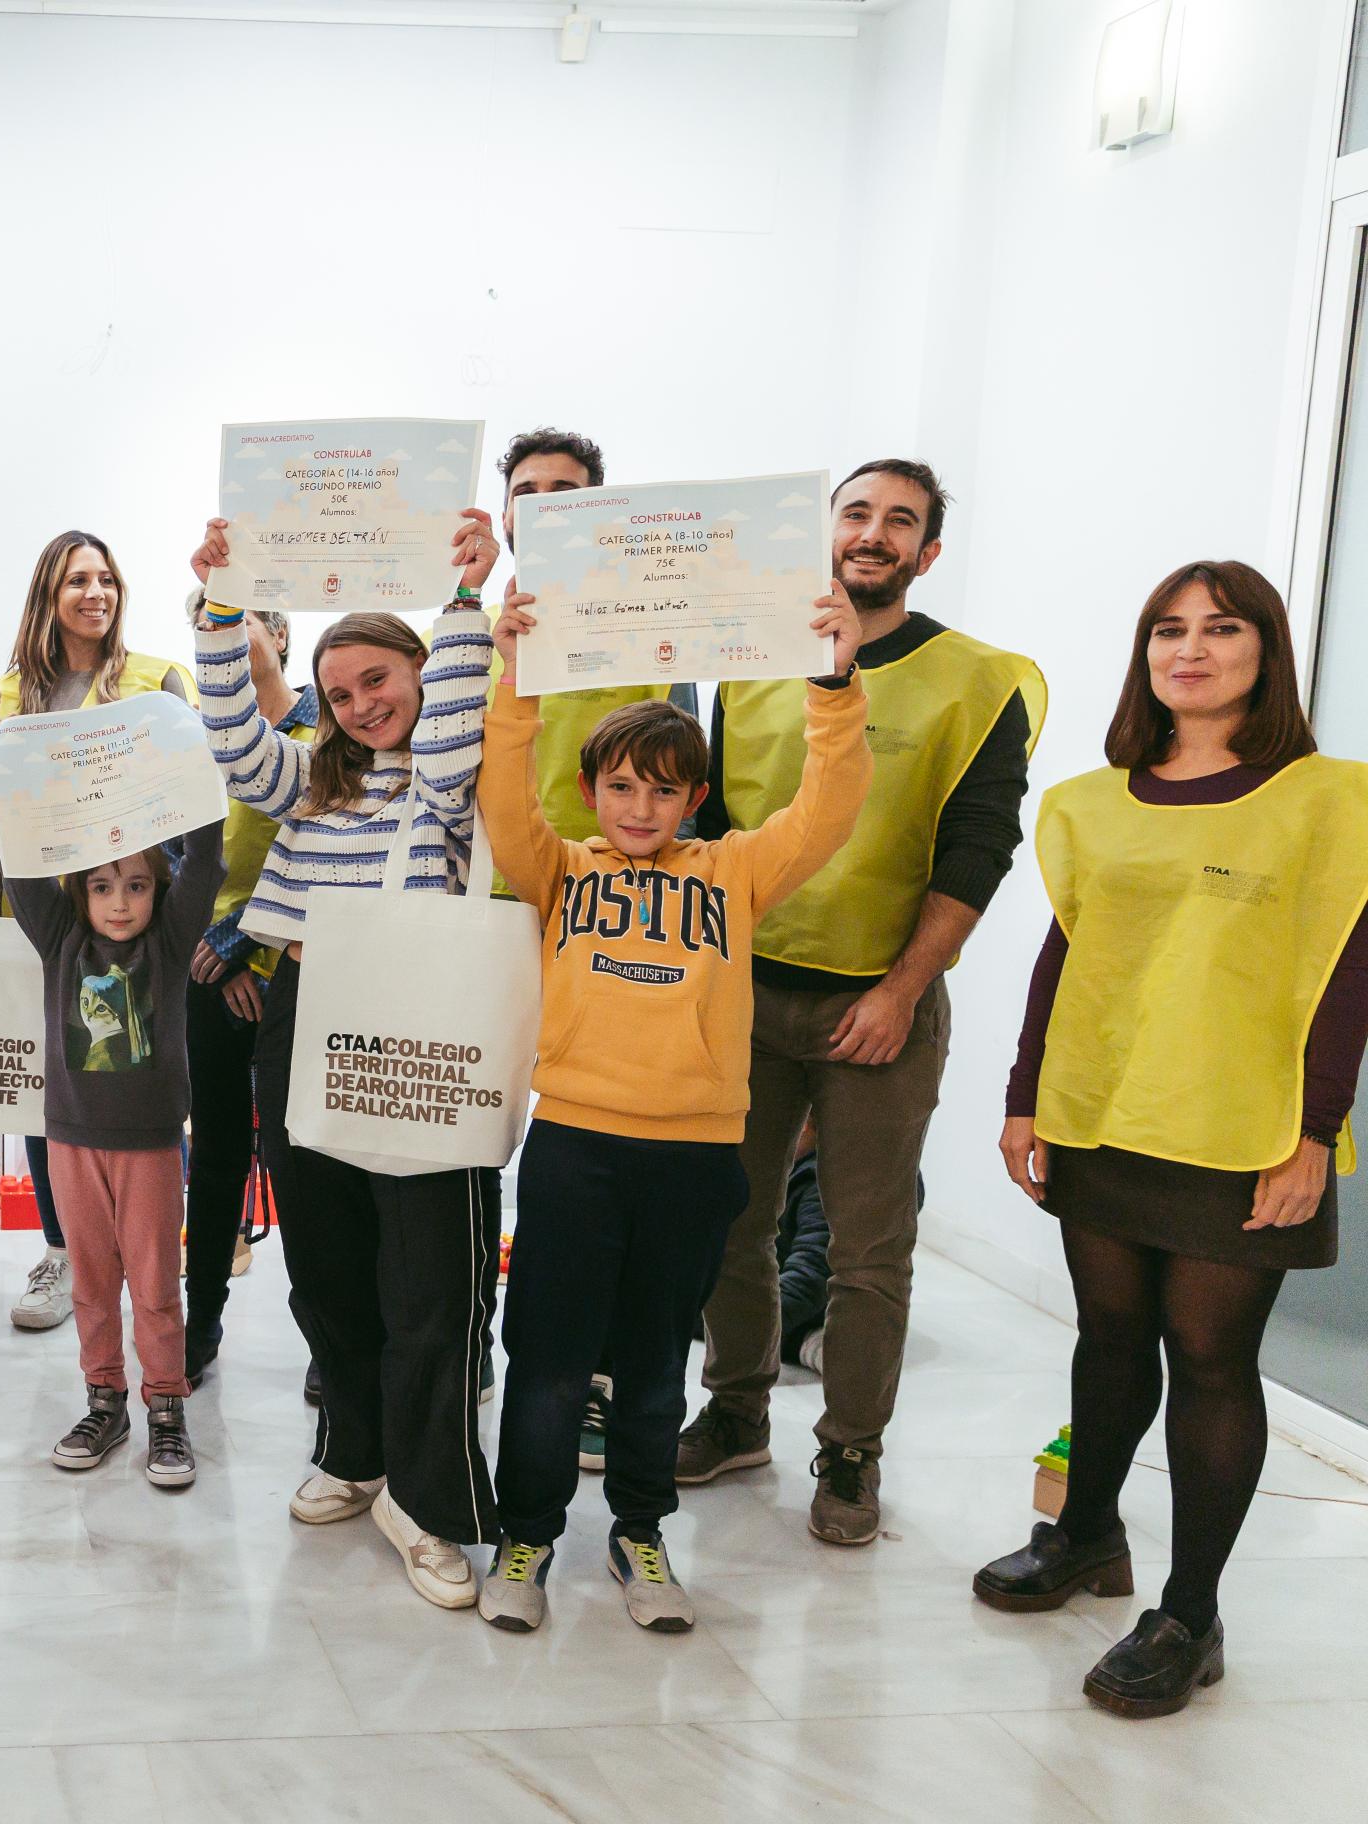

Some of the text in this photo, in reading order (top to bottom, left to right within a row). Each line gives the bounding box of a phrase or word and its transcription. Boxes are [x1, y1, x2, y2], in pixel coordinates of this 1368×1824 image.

[241, 434, 314, 444] DIPLOMA ACREDITATIVO
[313, 449, 372, 459] CONSTRULAB
[338, 469, 345, 478] C
[346, 468, 374, 479] (14-16
[376, 467, 399, 478] años)
[299, 481, 382, 491] SEGUNDO PREMIO
[331, 494, 348, 503] 50€
[320, 507, 357, 516] Alumnos:
[538, 498, 630, 513] DIPLOMA ACREDITATIVO
[630, 511, 702, 525] CONSTRULAB
[258, 533, 284, 544] ALMA
[599, 529, 734, 545] CATEGORÍA A (8-10 años)
[624, 543, 708, 557] PRIMER PREMIO
[656, 558, 676, 568] 75€
[643, 572, 688, 583] Alumnos:
[576, 602, 608, 616] Helios
[720, 645, 758, 653] ARQUI
[0, 725, 27, 735] DIPLOMA
[73, 724, 126, 742] CONSTRULAB
[100, 745, 106, 753] B
[107, 737, 130, 753] (11-13
[131, 728, 151, 743] años)
[72, 746, 134, 768] PRIMER PREMIO
[98, 764, 113, 774] 75€
[1203, 865, 1230, 876] CTAA
[597, 957, 680, 982] MASSACHUSETTS
[325, 1052, 471, 1085] TERRITORIAL
[325, 1072, 503, 1109] DEARQUITECTOS
[325, 1091, 459, 1126] DEALICANTE
